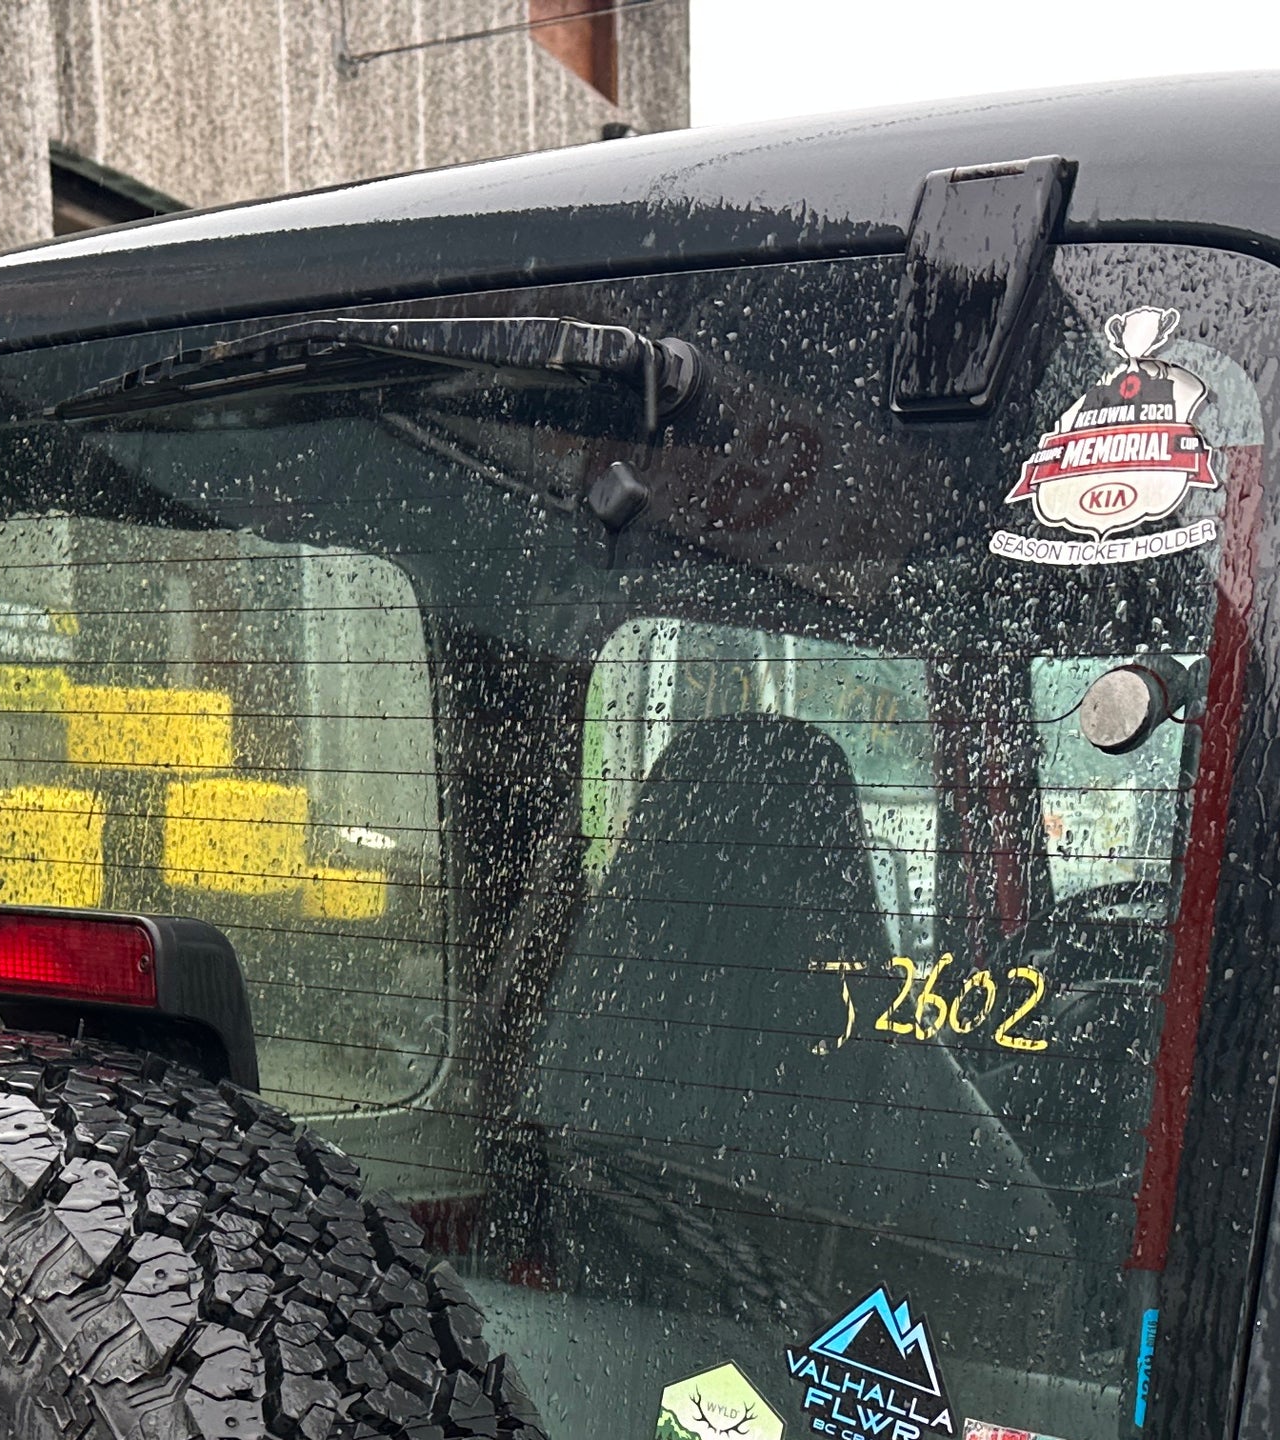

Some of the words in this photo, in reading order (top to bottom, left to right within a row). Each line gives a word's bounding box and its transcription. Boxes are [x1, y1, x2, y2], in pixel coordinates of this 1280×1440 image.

[1075, 405, 1136, 429] KELOWNA
[1140, 403, 1174, 421] 2020
[1060, 432, 1173, 470] MEMORIAL
[1180, 437, 1200, 451] CUP
[1088, 488, 1128, 510] KIA
[992, 532, 1062, 561] SEASON
[1069, 542, 1130, 561] TICKET
[1134, 522, 1214, 557] HOLDER
[785, 1348, 955, 1435] VALHALLA
[706, 1401, 739, 1420] WYLD
[812, 1417, 838, 1436] BC
